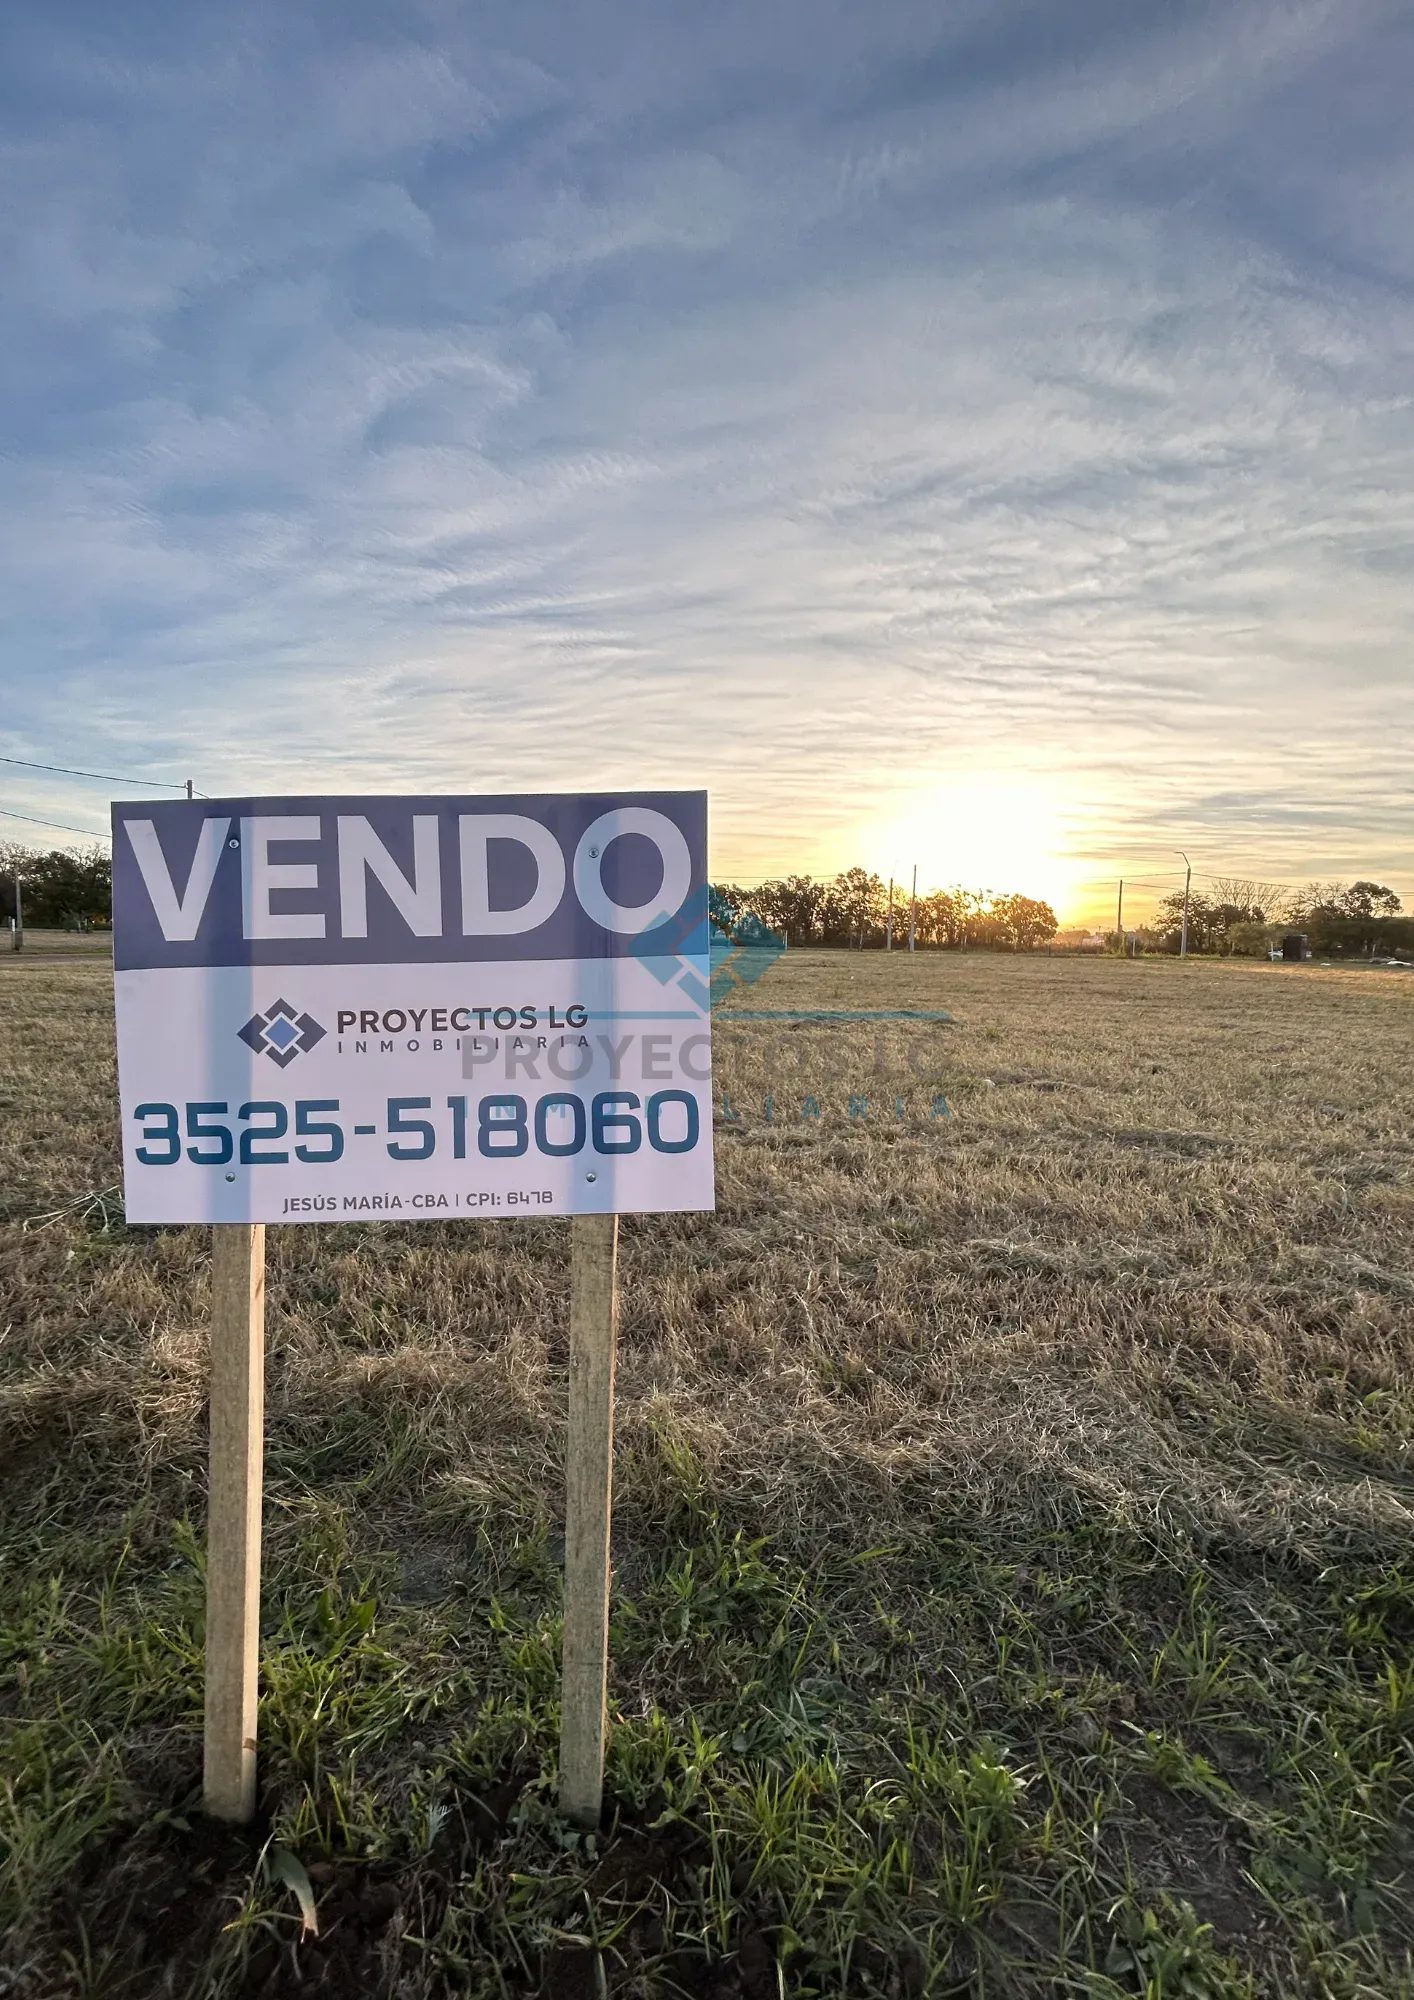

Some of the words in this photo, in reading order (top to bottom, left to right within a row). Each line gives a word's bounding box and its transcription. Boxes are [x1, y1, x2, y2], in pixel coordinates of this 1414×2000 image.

[123, 807, 692, 942] VENDO
[337, 1006, 538, 1034] PROYECTOS
[549, 1004, 589, 1029] LG
[338, 1035, 589, 1054] INMOBILIARIA
[133, 1089, 700, 1166] 3525-518060
[283, 1194, 337, 1214] JESÚS
[343, 1192, 449, 1211] MARÍA-CBA
[466, 1192, 501, 1207] CPI:
[507, 1191, 553, 1204] 6478
